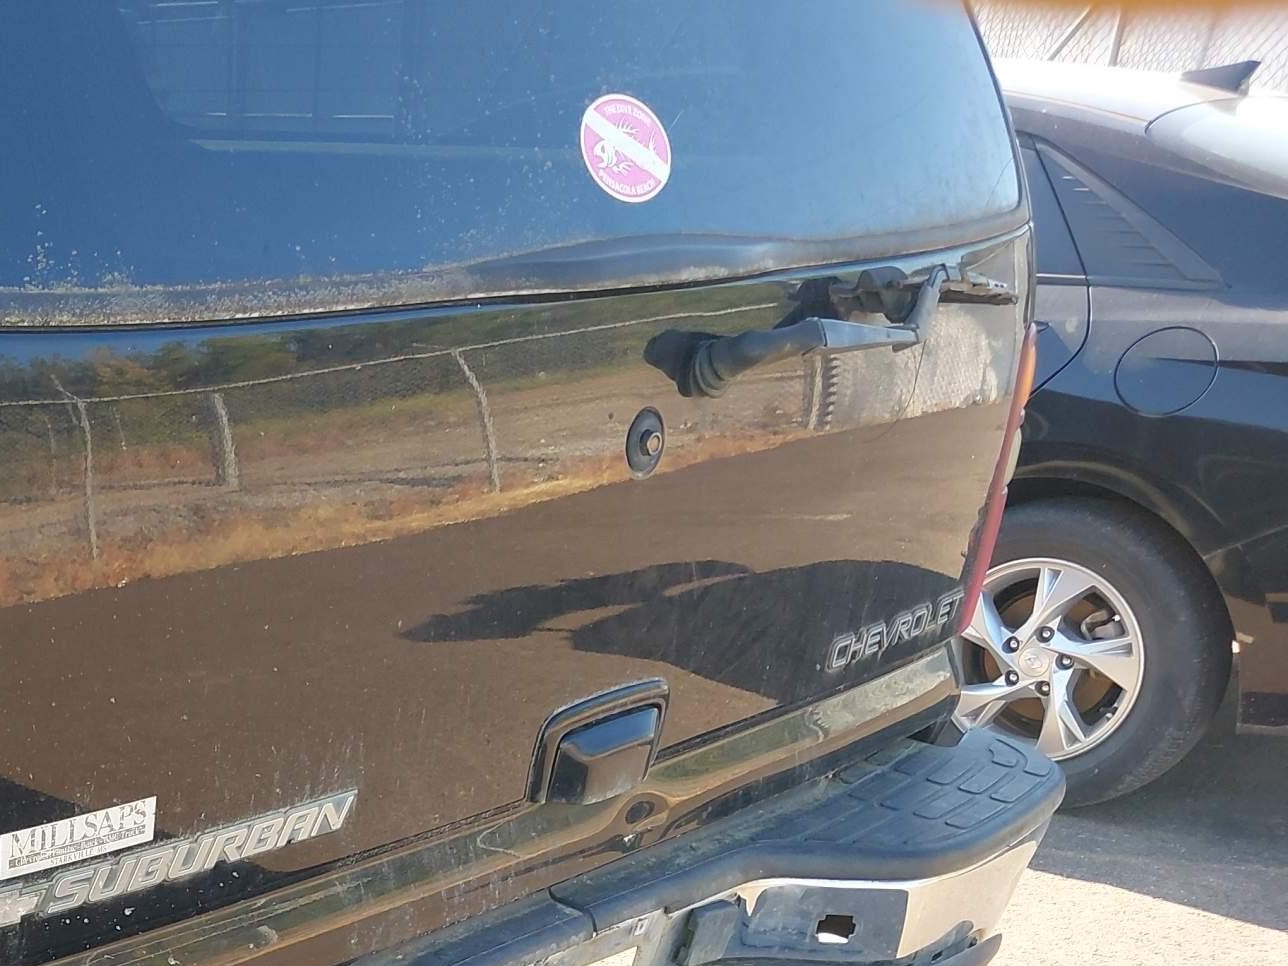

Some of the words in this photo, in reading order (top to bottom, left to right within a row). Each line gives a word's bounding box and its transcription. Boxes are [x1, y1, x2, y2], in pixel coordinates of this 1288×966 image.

[827, 588, 964, 670] CHEVROLET
[9, 800, 147, 858] MILLSAPS
[48, 790, 356, 913] SUBURBAN
